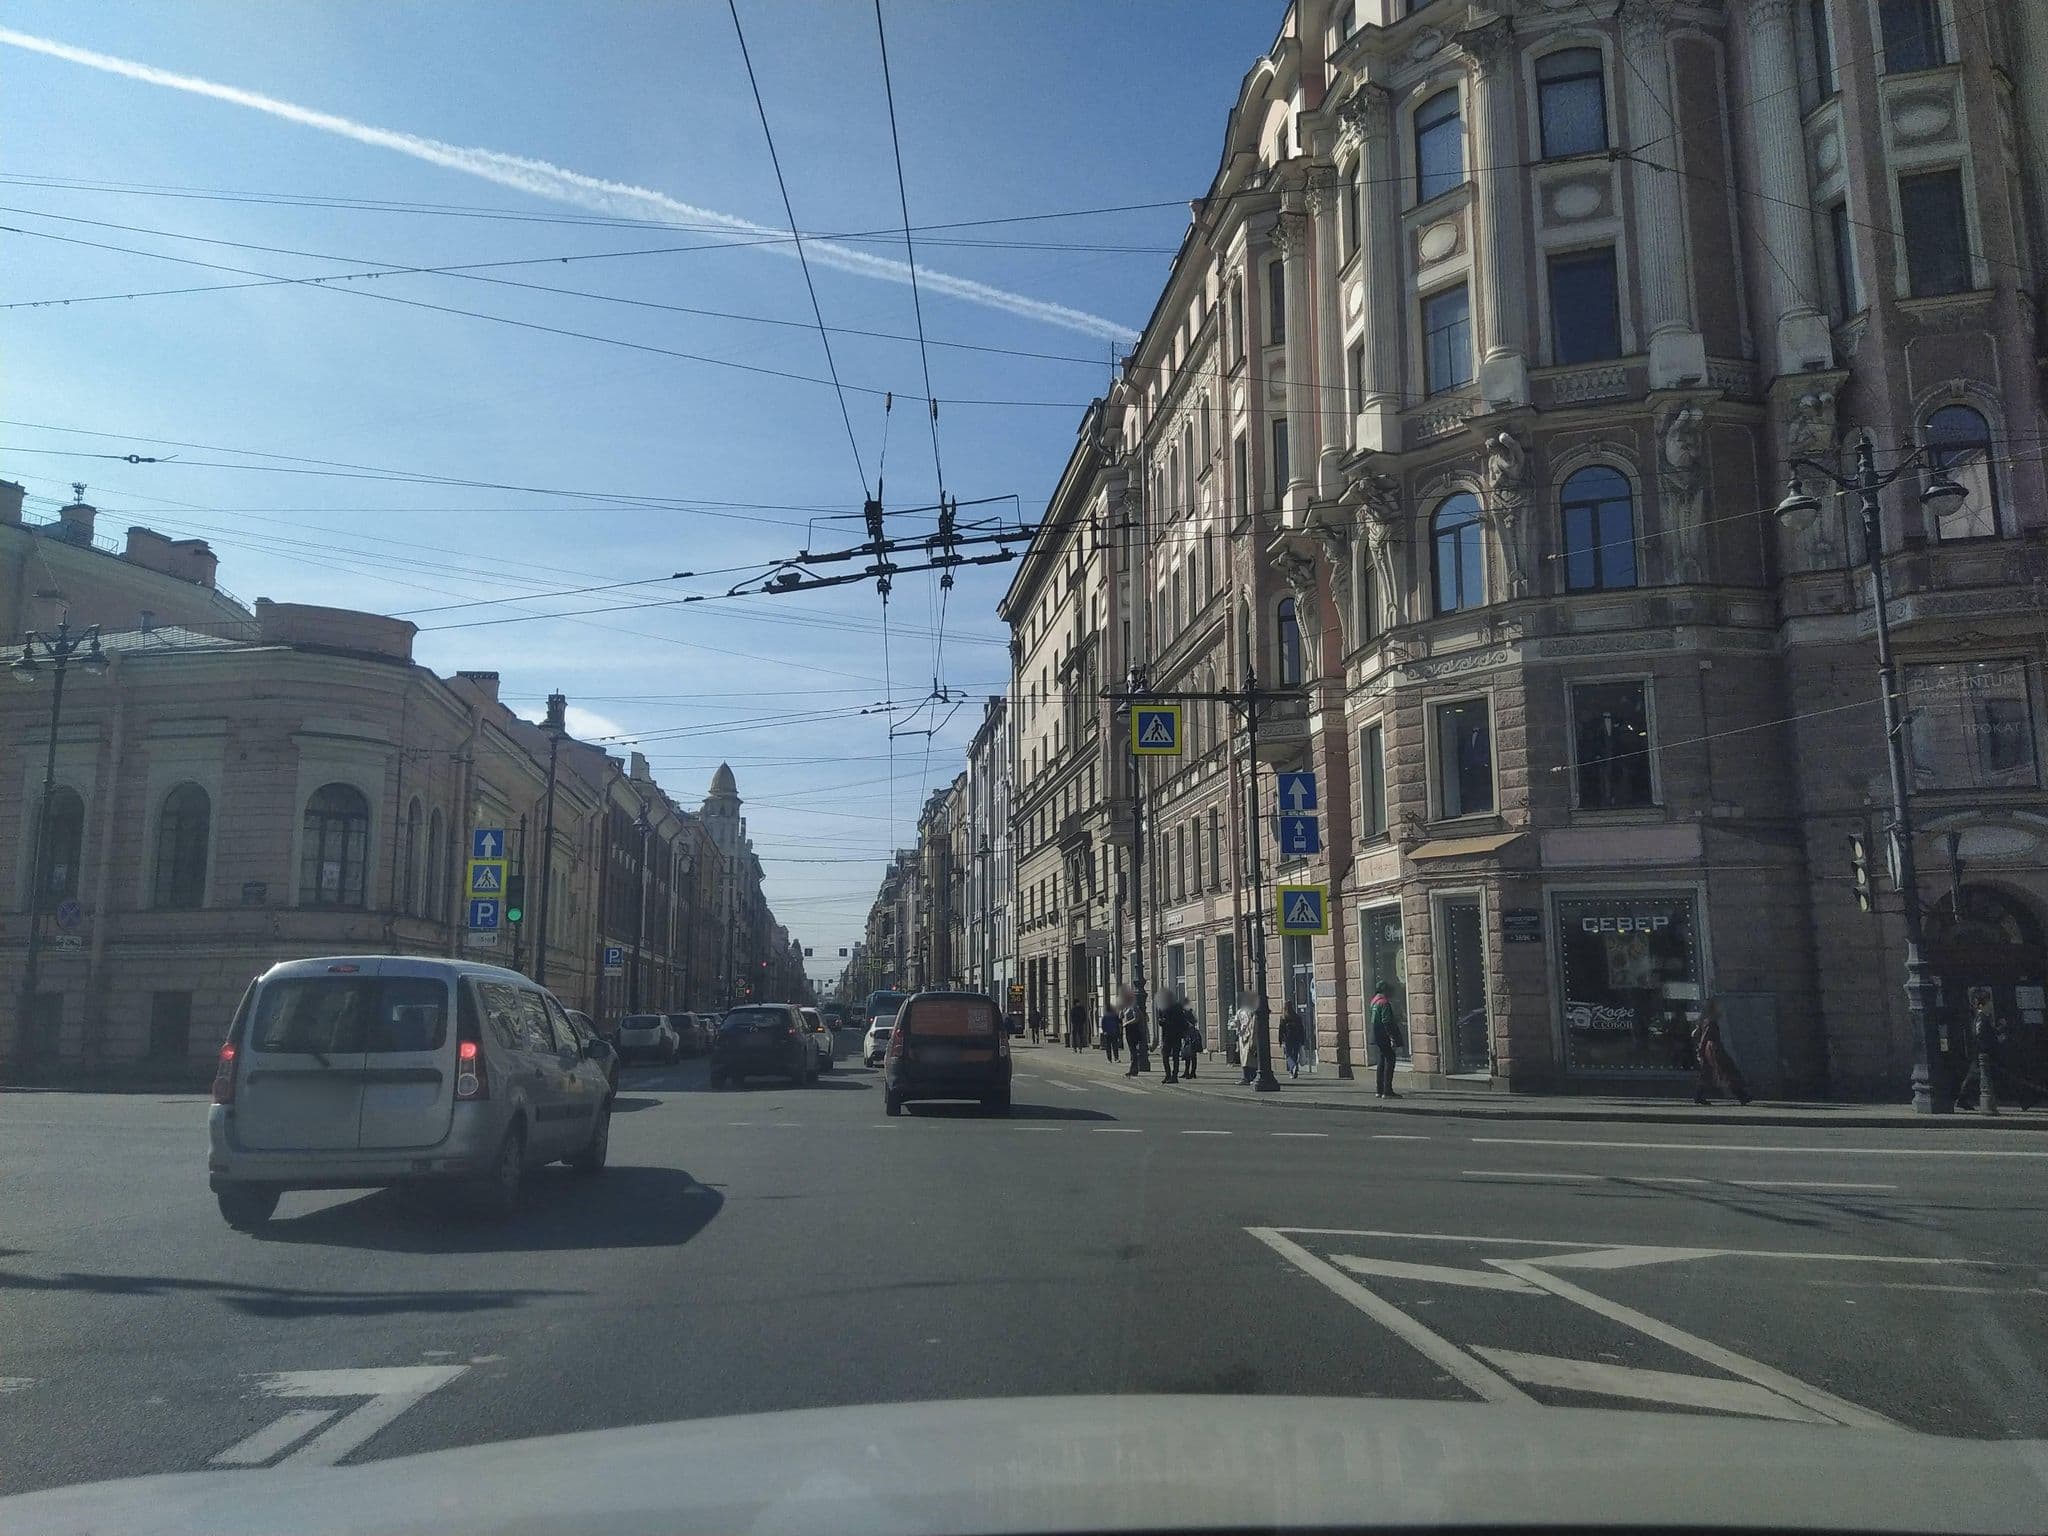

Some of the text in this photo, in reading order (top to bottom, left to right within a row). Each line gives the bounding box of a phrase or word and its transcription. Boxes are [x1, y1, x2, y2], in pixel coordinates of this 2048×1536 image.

[1960, 722, 2021, 736] ПРОКАТ
[477, 903, 493, 925] P
[1582, 916, 1669, 931] СЕВЕР
[609, 949, 619, 963] P
[1592, 1005, 1635, 1020] Кофе
